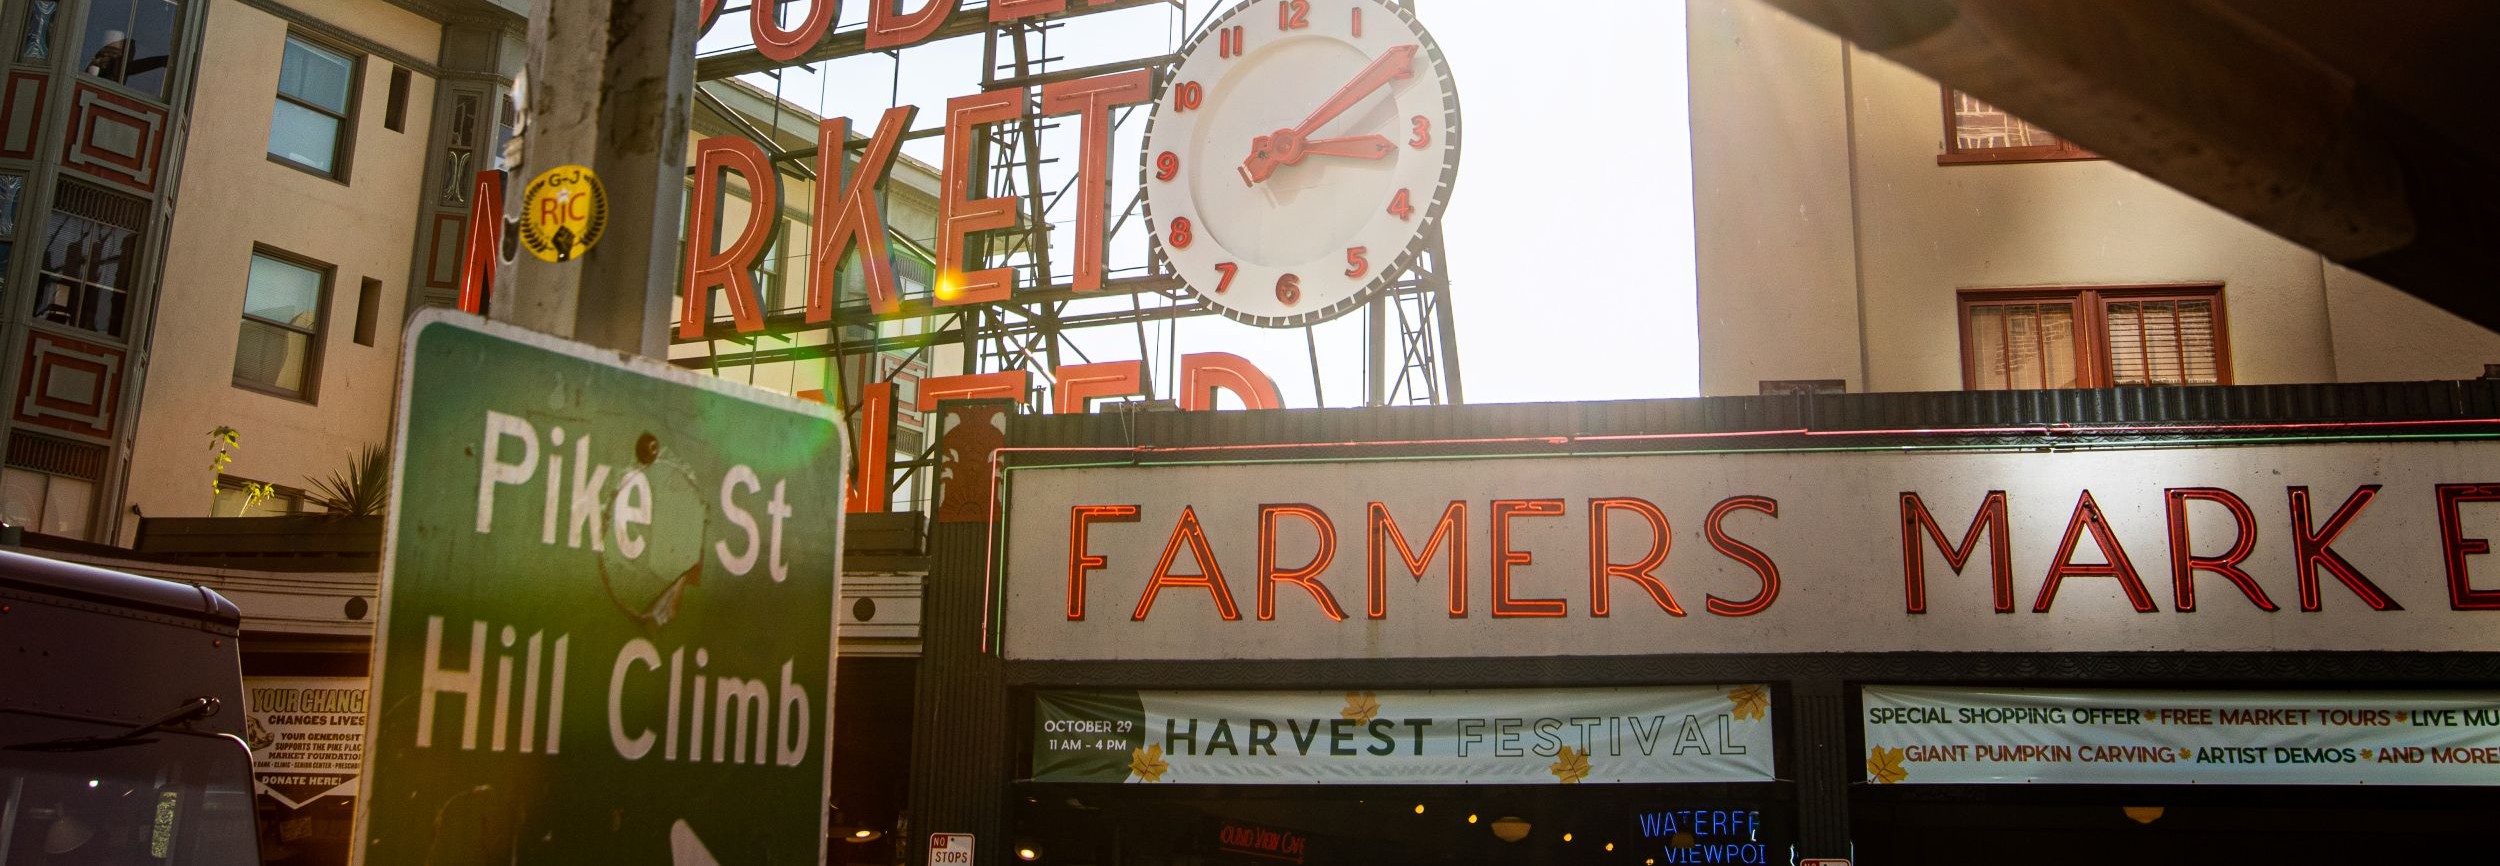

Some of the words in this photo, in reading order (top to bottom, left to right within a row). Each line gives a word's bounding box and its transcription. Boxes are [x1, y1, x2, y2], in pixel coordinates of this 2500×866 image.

[1279, 0, 1310, 31] 12
[1352, 7, 1361, 37] 1
[1220, 26, 1243, 58] 11
[1174, 81, 1202, 112] 10
[1409, 115, 1431, 148] 3
[1156, 151, 1179, 181] 9
[1387, 188, 1414, 222] 4
[1169, 216, 1192, 248] 8
[1215, 262, 1238, 293] 7
[1345, 246, 1368, 278] 5
[1276, 273, 1300, 305] 6
[475, 411, 652, 559] Pike
[715, 465, 792, 583] St
[1067, 495, 1781, 621] FARMERS
[1899, 484, 2500, 614] MARKE
[252, 689, 300, 713] YOUR
[416, 615, 569, 754] Hill
[608, 638, 810, 766] Climb
[268, 715, 327, 725] CHANGES
[330, 716, 365, 726] LIVES
[1044, 720, 1112, 733] OCTOBER
[1117, 720, 1132, 733] 29
[1869, 707, 1952, 724] SPECIAL
[1959, 707, 2066, 724] SHOPPING
[2072, 708, 2140, 725] OFFER
[2161, 709, 2212, 725] FREE
[2220, 709, 2310, 726] MARKET
[2317, 709, 2391, 726] TOURS
[2411, 709, 2457, 726] LIVE
[275, 743, 312, 751] SUPPORTS
[313, 743, 326, 751] THE
[327, 743, 342, 751] PIKE
[1049, 740, 1057, 750] 11
[1061, 740, 1081, 750] AM
[1095, 739, 1103, 750] 4
[1107, 739, 1126, 750] PM
[1165, 718, 1432, 756] HARVEST
[1457, 714, 1746, 757] FESTIVAL
[1905, 745, 1968, 762] GIANT
[1976, 745, 2072, 762] PUMPKIN
[2078, 745, 2176, 763] CARVING
[2196, 747, 2268, 764] ARTIST
[2275, 747, 2356, 764] DEMOS
[2377, 747, 2424, 764] AND
[262, 776, 306, 785] DONATE
[309, 776, 341, 785] HERE!
[933, 837, 946, 846] NO
[936, 851, 967, 863] STOPS
